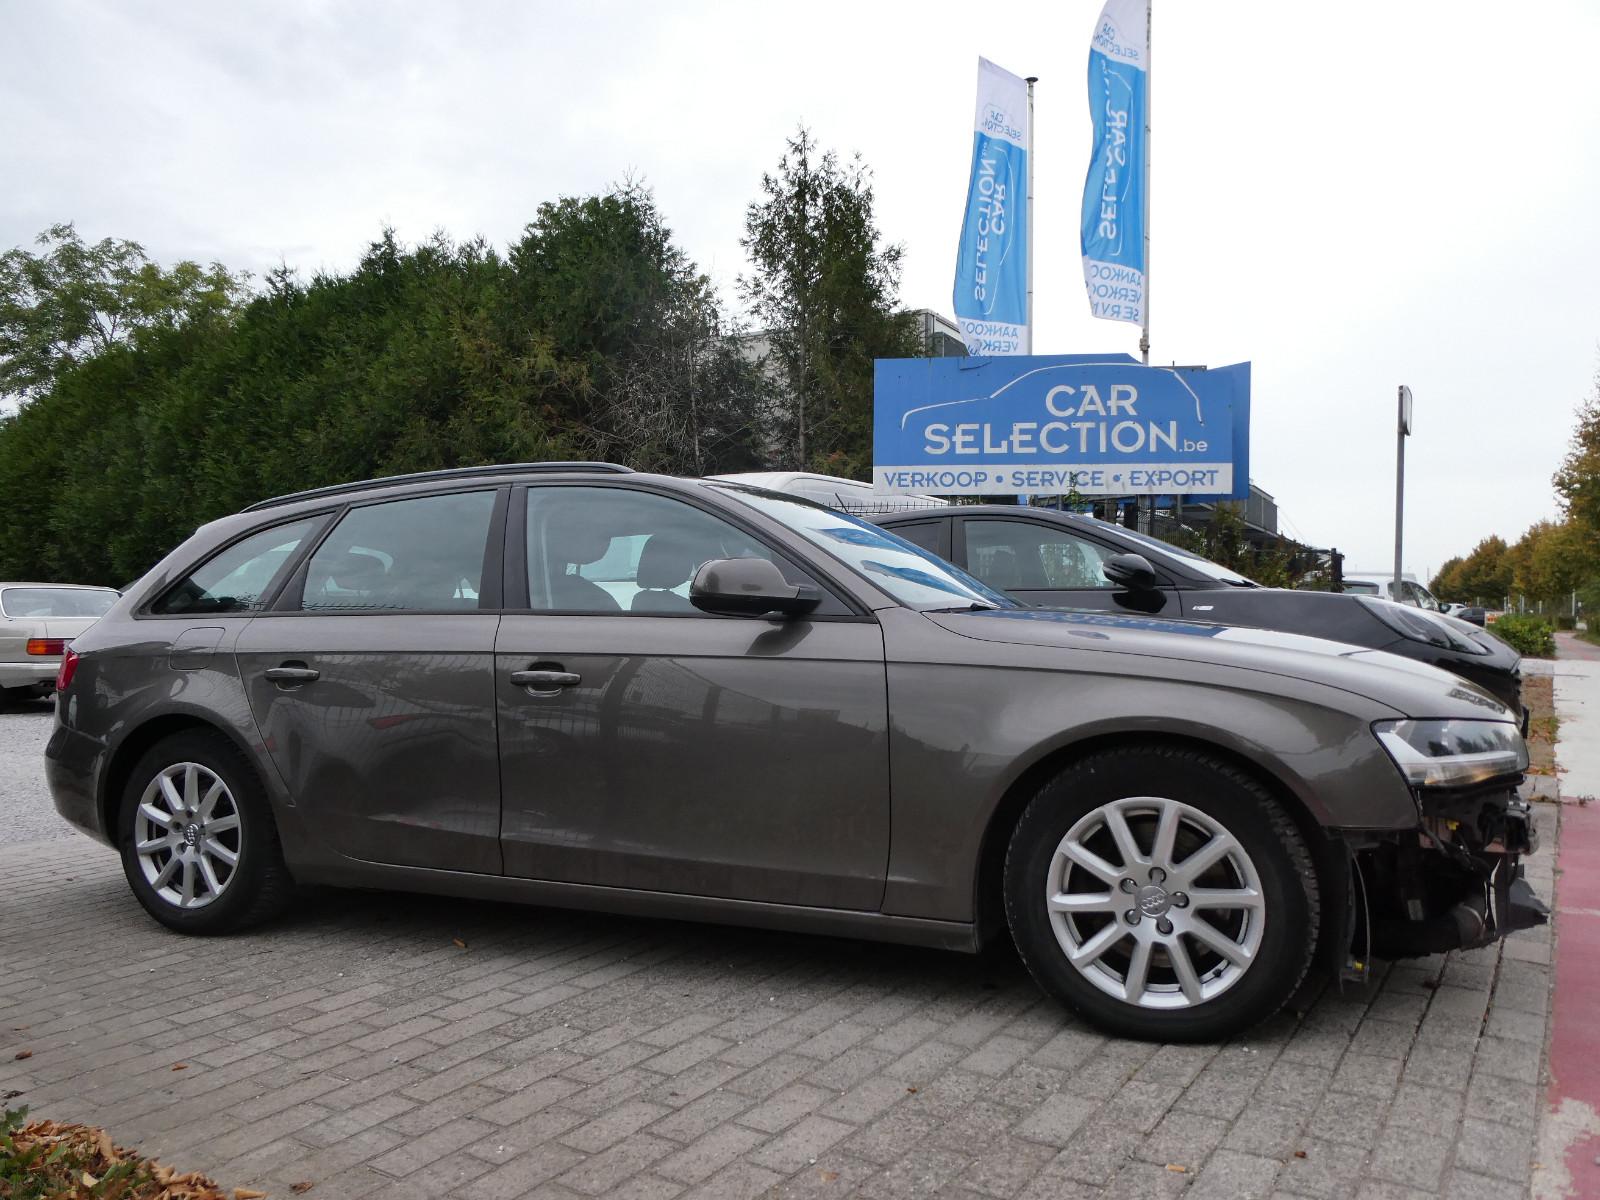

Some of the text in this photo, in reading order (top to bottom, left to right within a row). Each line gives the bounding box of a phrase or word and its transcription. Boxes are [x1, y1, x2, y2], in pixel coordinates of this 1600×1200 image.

[1045, 384, 1138, 417] CAR
[884, 469, 1219, 488] VERKOOP SERVICE EXPORT
